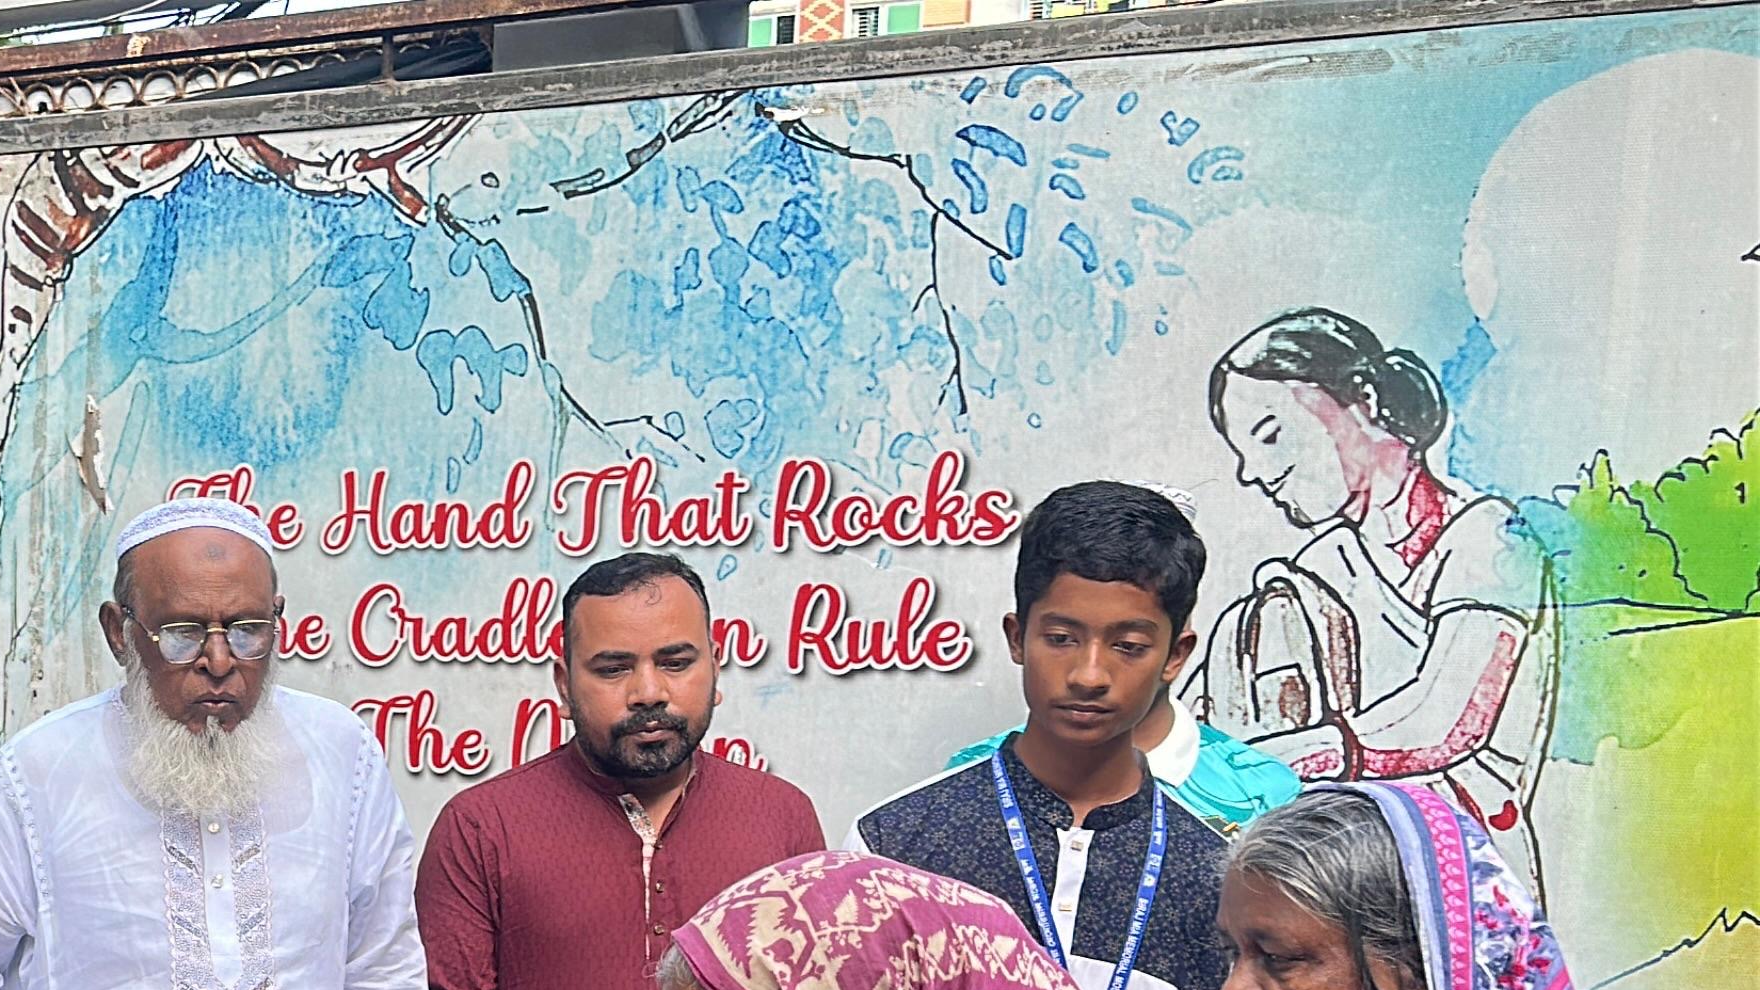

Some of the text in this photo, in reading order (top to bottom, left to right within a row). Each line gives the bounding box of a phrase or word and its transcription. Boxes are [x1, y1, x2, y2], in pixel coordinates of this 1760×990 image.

[322, 461, 533, 552] Hand
[553, 456, 750, 553] That
[772, 450, 1020, 548] Rocks
[787, 577, 973, 674] Rule
[352, 689, 486, 770] The
[1116, 935, 1139, 974] MEMORIAL
